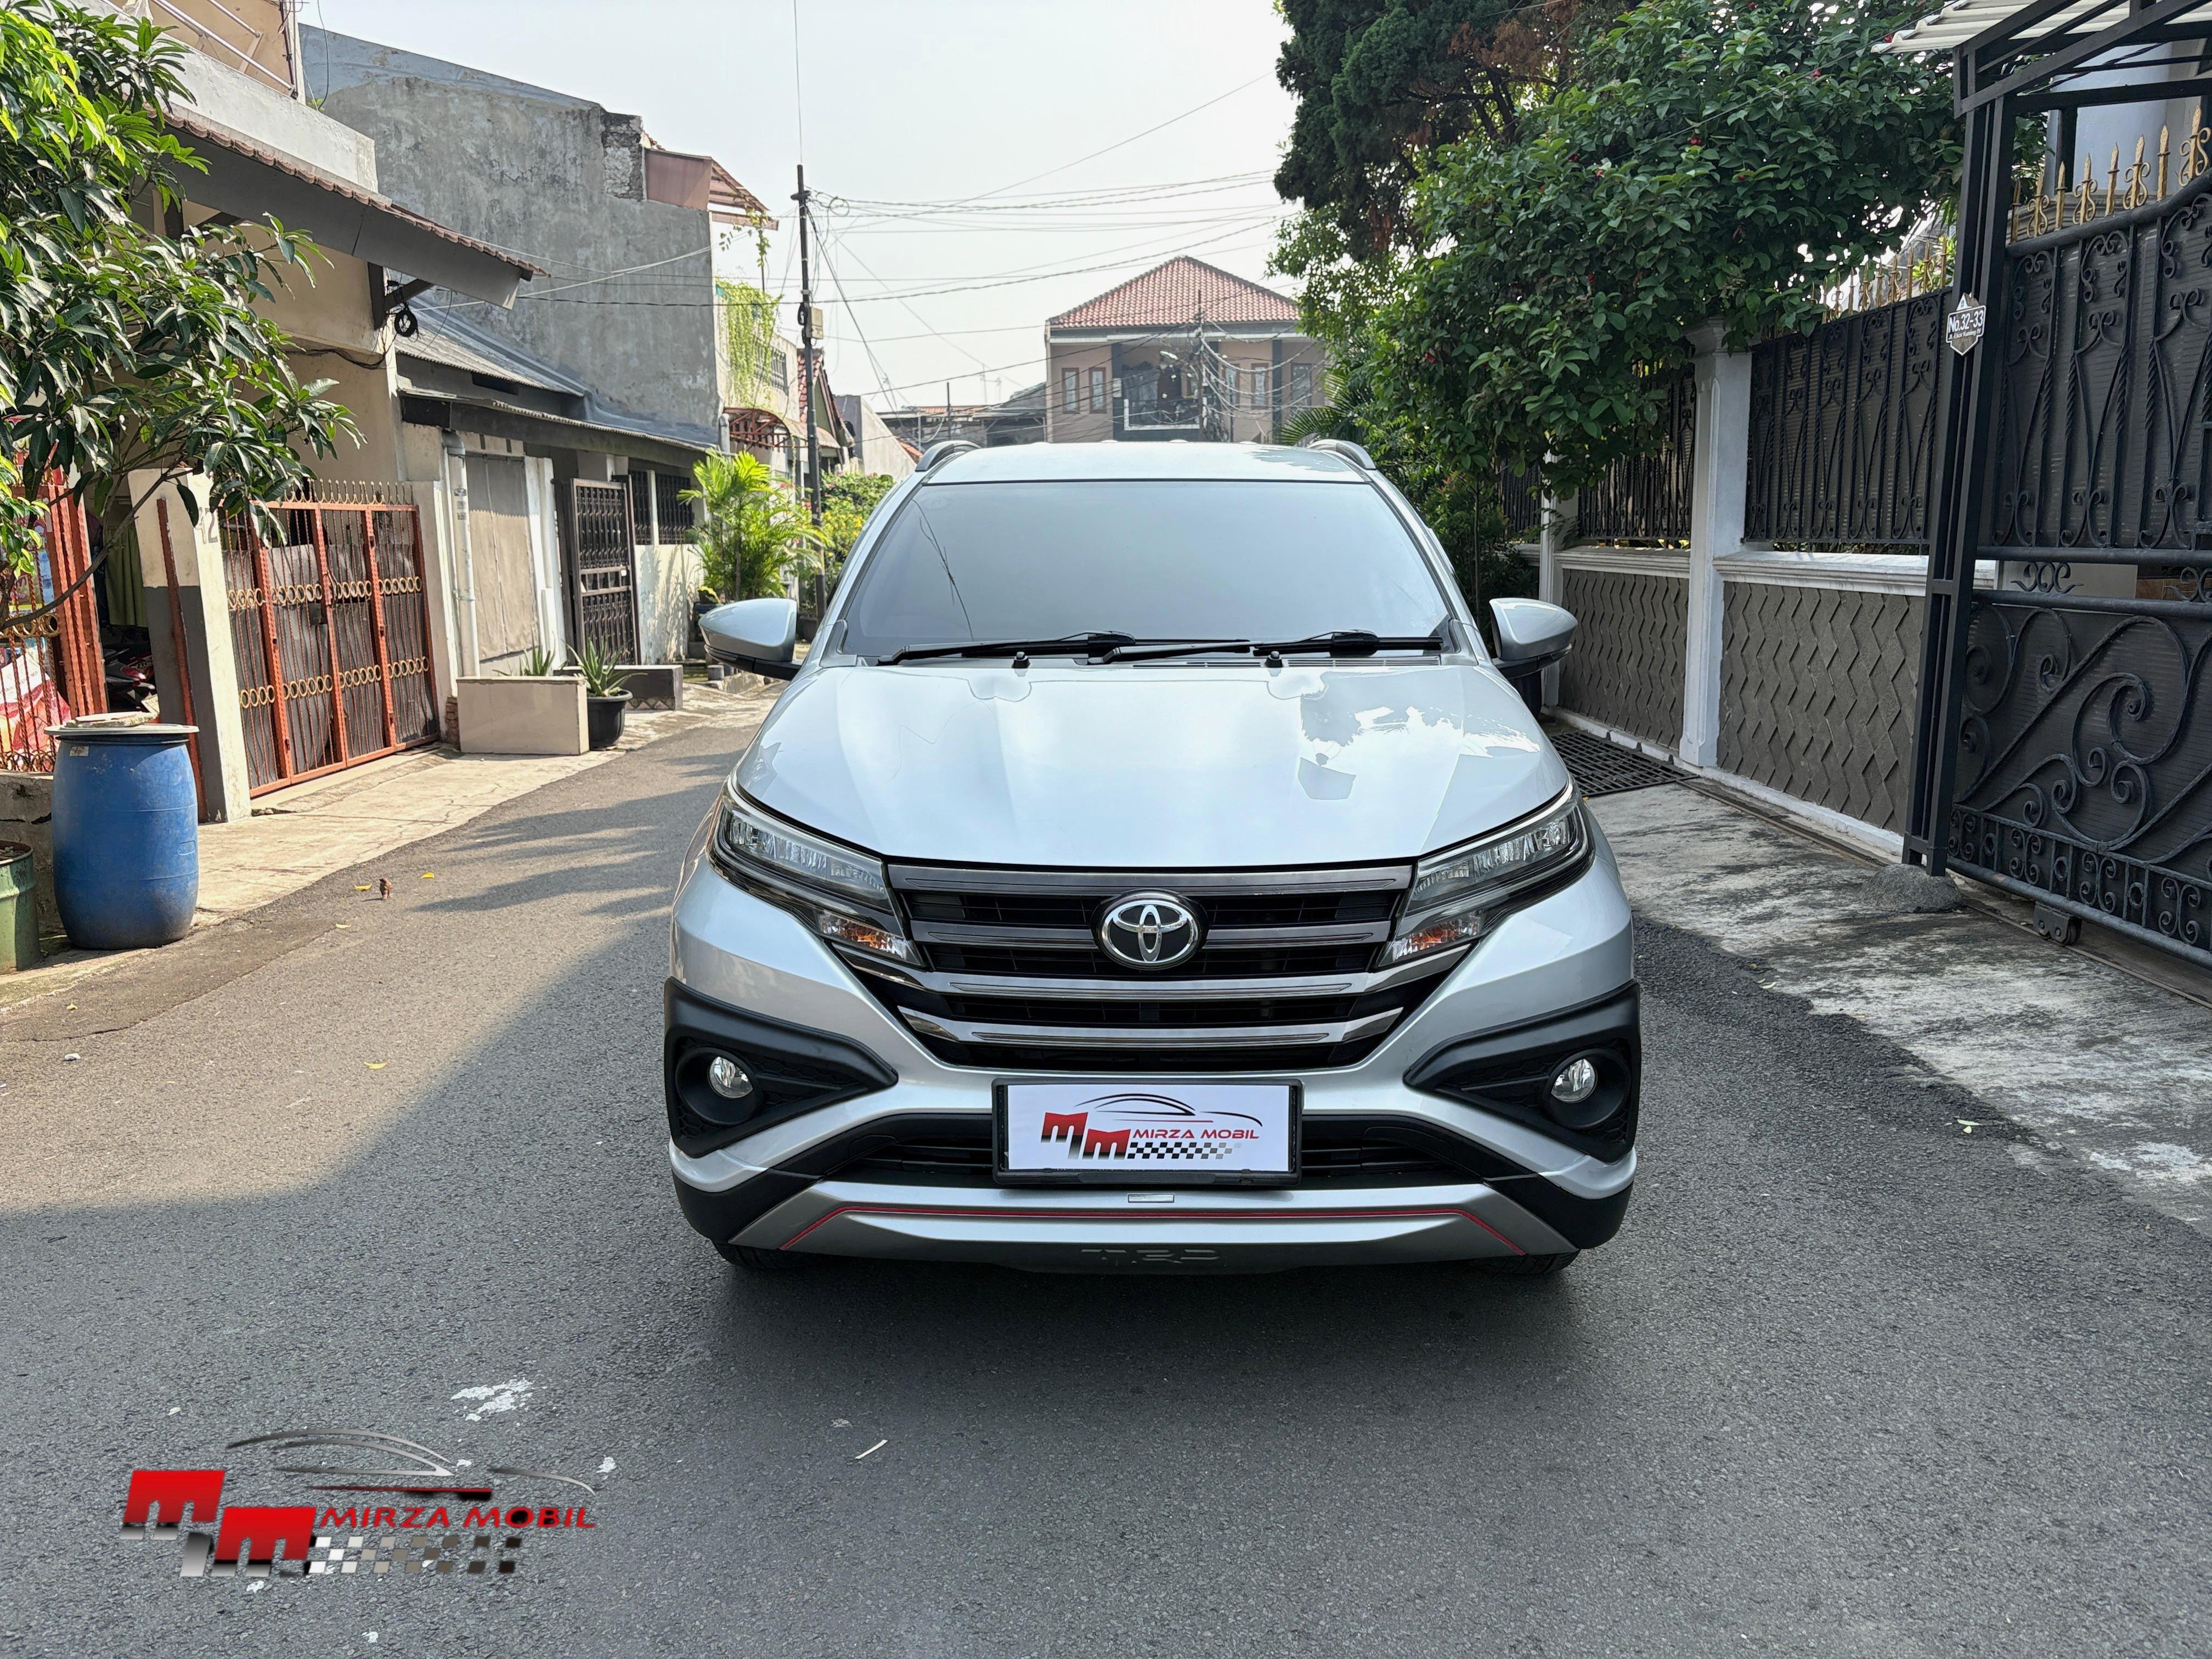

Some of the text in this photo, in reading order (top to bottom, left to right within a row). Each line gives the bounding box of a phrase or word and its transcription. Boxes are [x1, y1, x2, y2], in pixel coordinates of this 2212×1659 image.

[1948, 310, 1984, 334] No.32-33
[1132, 1128, 1260, 1139] MIRZA MOBIL
